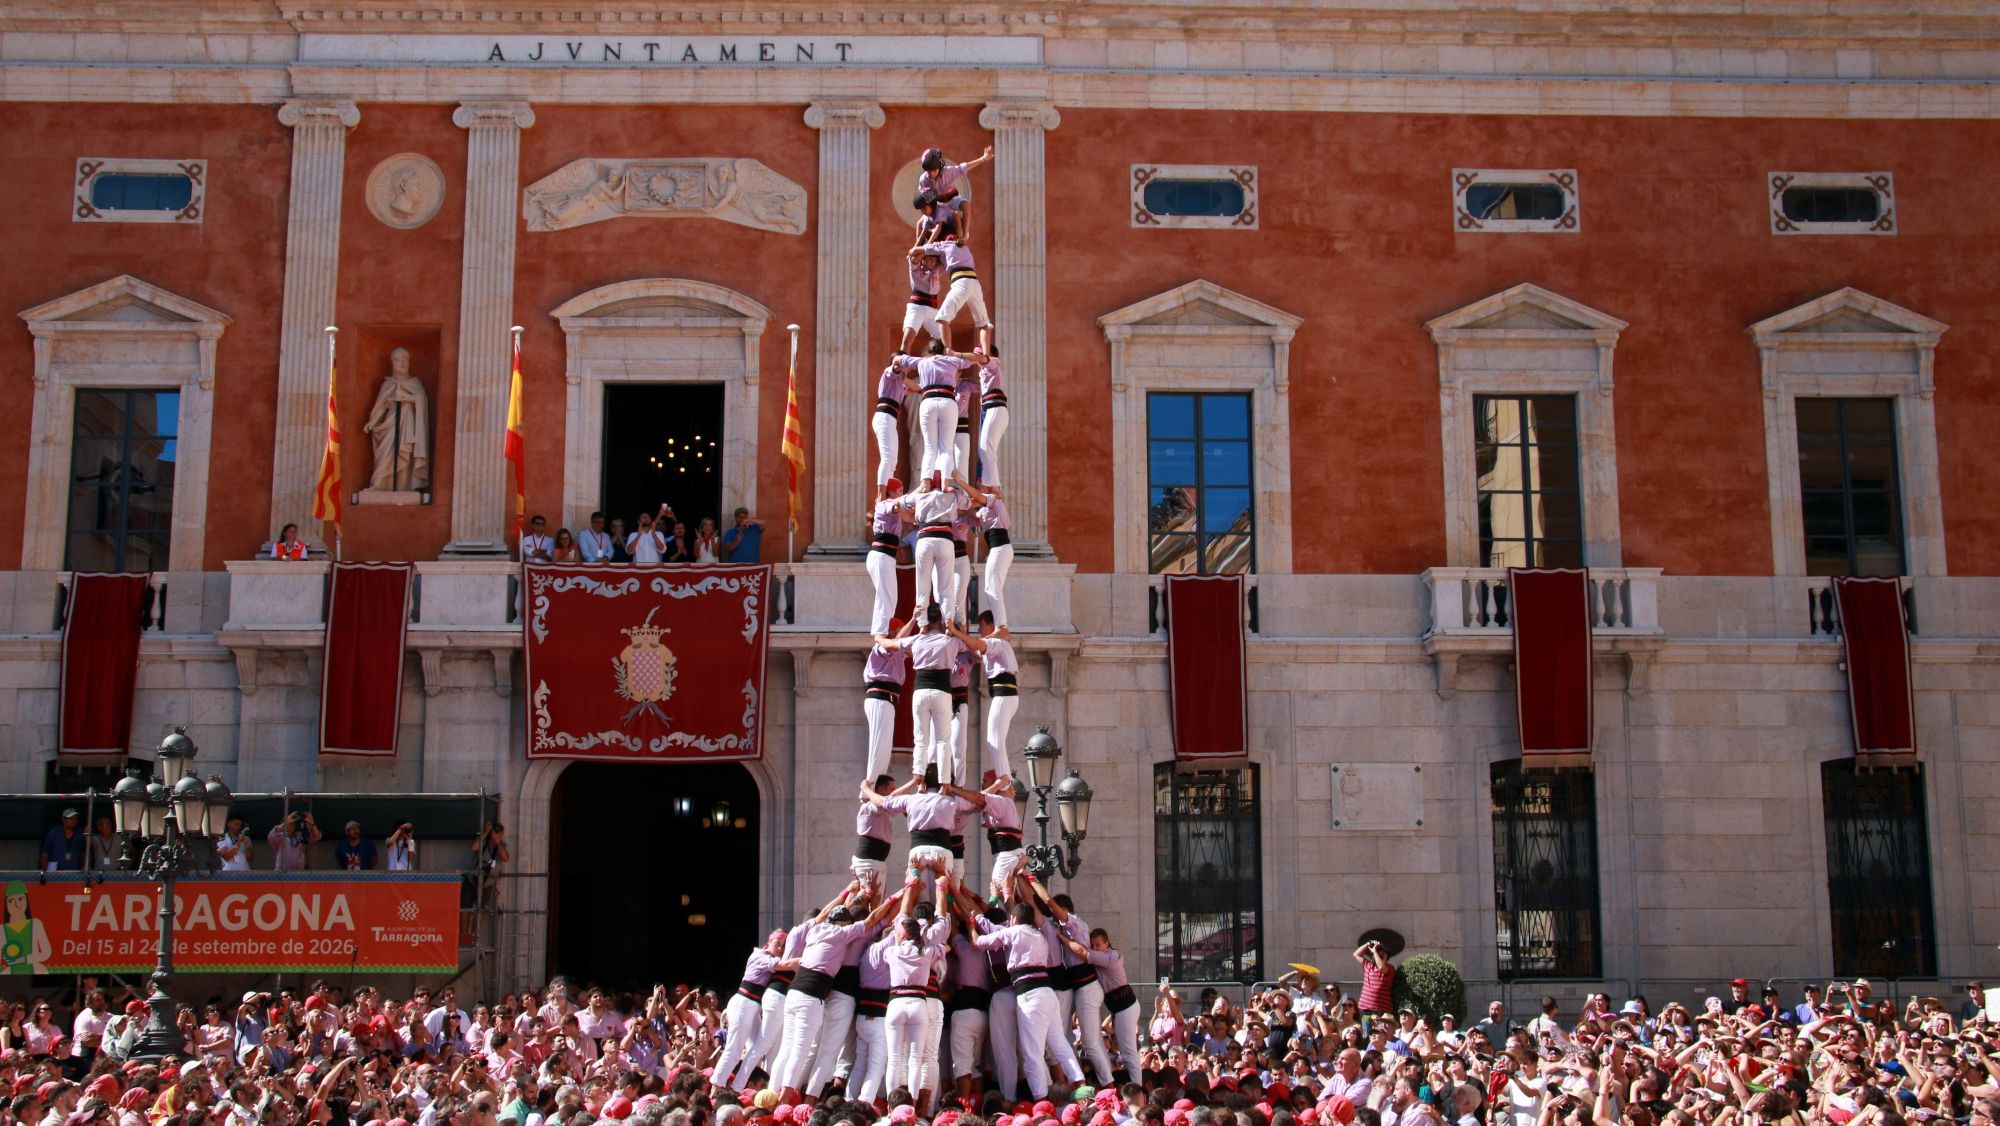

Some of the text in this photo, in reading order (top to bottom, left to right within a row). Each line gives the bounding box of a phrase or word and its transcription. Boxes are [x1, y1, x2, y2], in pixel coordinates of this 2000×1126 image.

[488, 42, 852, 62] AJVNTAMENT
[64, 893, 356, 932] TARRAGONA
[63, 939, 91, 955] Del
[97, 939, 113, 955] 15
[119, 938, 134, 955] al
[138, 938, 160, 955] 24
[193, 938, 276, 955] setembre
[281, 938, 304, 955] de
[309, 938, 354, 955] 2026
